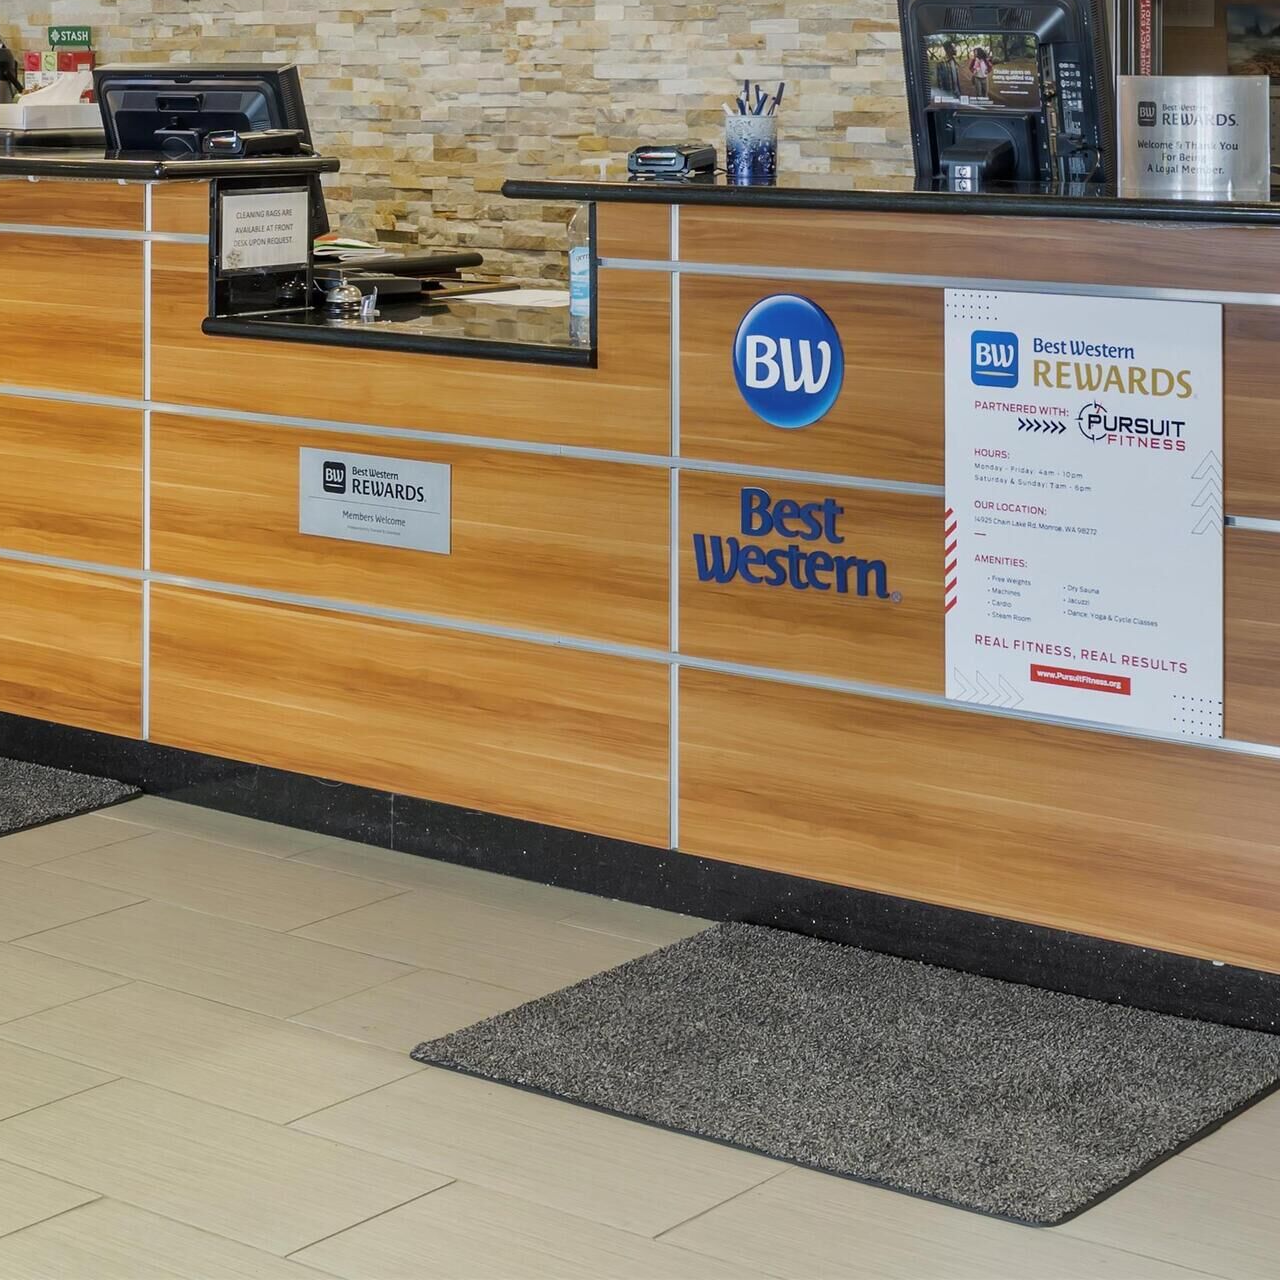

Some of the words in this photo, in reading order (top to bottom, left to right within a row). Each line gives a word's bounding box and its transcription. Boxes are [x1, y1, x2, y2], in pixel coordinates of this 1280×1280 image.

[61, 31, 88, 41] STASH
[1140, 107, 1155, 117] BW
[1137, 140, 1173, 149] Welcome
[1220, 142, 1239, 151] You
[1162, 153, 1176, 161] For
[1155, 164, 1179, 175] Loyal
[236, 210, 265, 219] CLEANING
[235, 225, 265, 233] AVAILABLE
[274, 223, 293, 231] FRONT
[233, 239, 248, 247] DESK
[249, 238, 266, 246] UPON
[976, 342, 1014, 368] BW
[1033, 337, 1067, 355] Best
[1070, 340, 1135, 359] Western
[745, 334, 832, 394] BW
[1033, 359, 1193, 399] REWARDS
[974, 400, 1037, 414] PARTNERED
[1039, 406, 1069, 417] WITH:
[1088, 413, 1186, 437] PURSUIT
[1108, 434, 1186, 451] FITNESS
[974, 448, 1010, 460] HOURS:
[326, 468, 344, 482] BW
[352, 466, 368, 477] Best
[369, 468, 399, 480] Western
[974, 463, 1002, 472] Monday
[1062, 471, 1083, 479] 10pm
[974, 474, 1008, 484] Saturday
[740, 486, 844, 544] Best
[974, 500, 994, 510] OUR
[996, 502, 1047, 516] LOCATION:
[342, 510, 374, 523] Members
[375, 514, 406, 527] Welcome
[1065, 525, 1077, 533] WA
[693, 533, 890, 600] Western
[974, 554, 1028, 568] AMENITIES:
[991, 575, 1005, 583] Free
[1006, 577, 1031, 586] Weights
[991, 587, 1021, 597] Machines
[1067, 585, 1078, 593] Dry
[1079, 586, 1100, 595] Sauna
[991, 599, 1012, 608] Cardio
[991, 611, 1012, 620] Steam
[1013, 614, 1031, 622] Room
[1090, 613, 1107, 622] Yoga
[1114, 615, 1132, 624] Cycle
[1132, 617, 1158, 627] Classes
[975, 634, 1009, 649] REAL
[1013, 639, 1076, 659] FITNESS,
[1081, 648, 1117, 664] REAL
[1122, 654, 1188, 674] RESULTS
[1036, 668, 1122, 689] www.PursuitFitness.org
